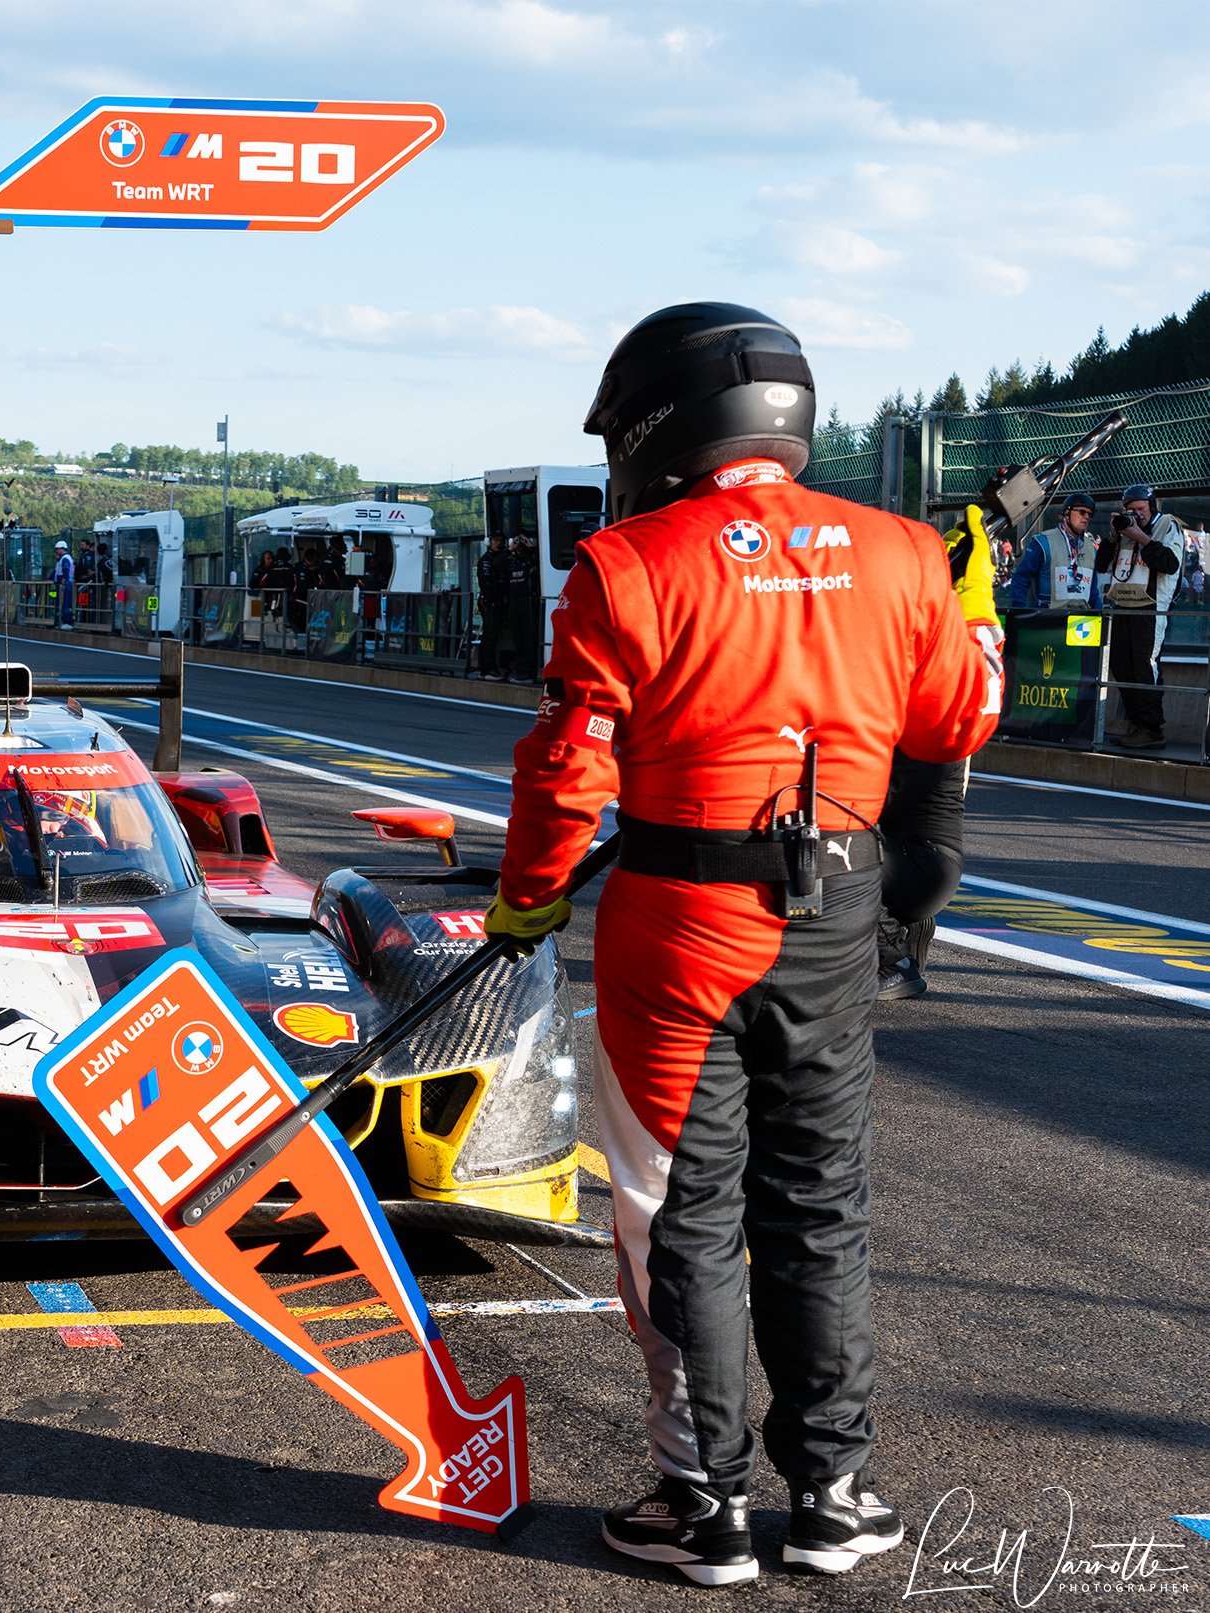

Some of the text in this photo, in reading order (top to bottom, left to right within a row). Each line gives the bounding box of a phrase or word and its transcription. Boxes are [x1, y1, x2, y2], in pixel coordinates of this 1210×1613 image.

[239, 141, 356, 184] 20
[111, 181, 215, 201] Team WRT
[770, 391, 793, 401] BELL
[355, 509, 382, 518] 30
[743, 572, 853, 594] Motorsport
[1018, 684, 1070, 709] ROLEX
[8, 763, 119, 777] Motorsport
[413, 948, 441, 956] Our
[266, 963, 303, 989] Shell
[79, 996, 181, 1087] Team WRT
[132, 1065, 283, 1207] 20
[202, 1173, 238, 1209] WRT
[427, 1420, 505, 1498] READY
[458, 1455, 503, 1505] GET
